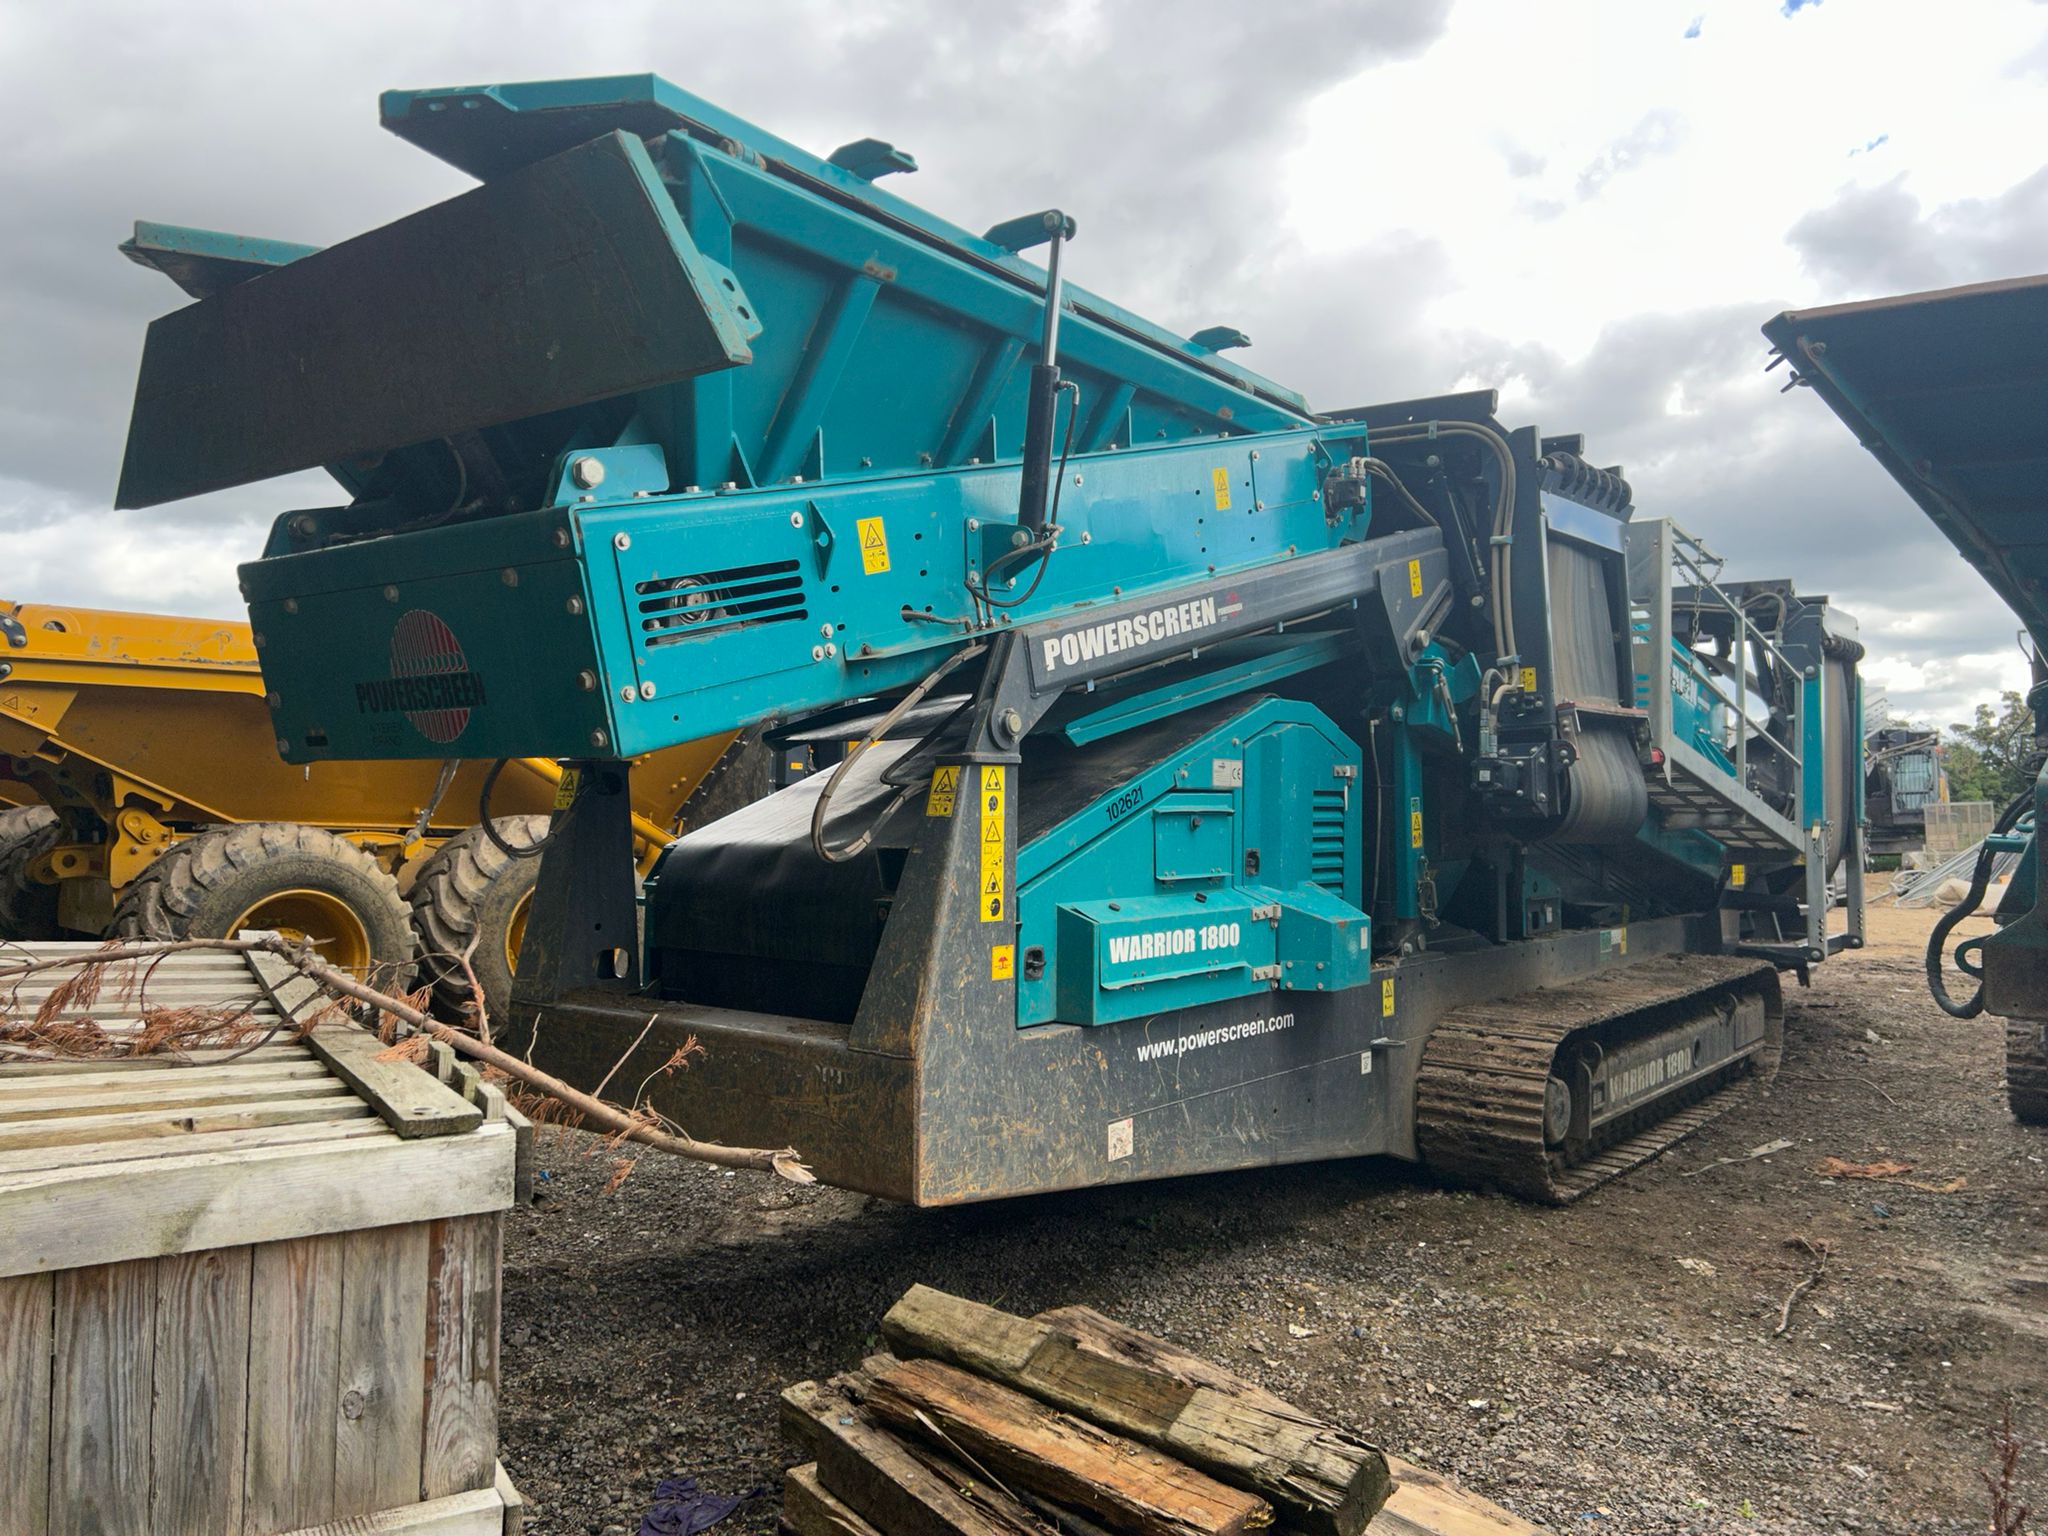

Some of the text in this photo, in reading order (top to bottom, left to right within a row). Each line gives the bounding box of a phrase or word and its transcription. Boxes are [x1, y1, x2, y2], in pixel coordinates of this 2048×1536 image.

[1043, 596, 1217, 672] POWERSCREEN
[354, 671, 487, 714] POWERSCREEN
[1105, 785, 1144, 821] 102621
[1109, 922, 1240, 964] WARRIOR 1800
[1137, 1012, 1295, 1063] www.powerscreen.com
[1609, 1057, 1664, 1103] WARRIOR
[1665, 1047, 1691, 1079] 1800
